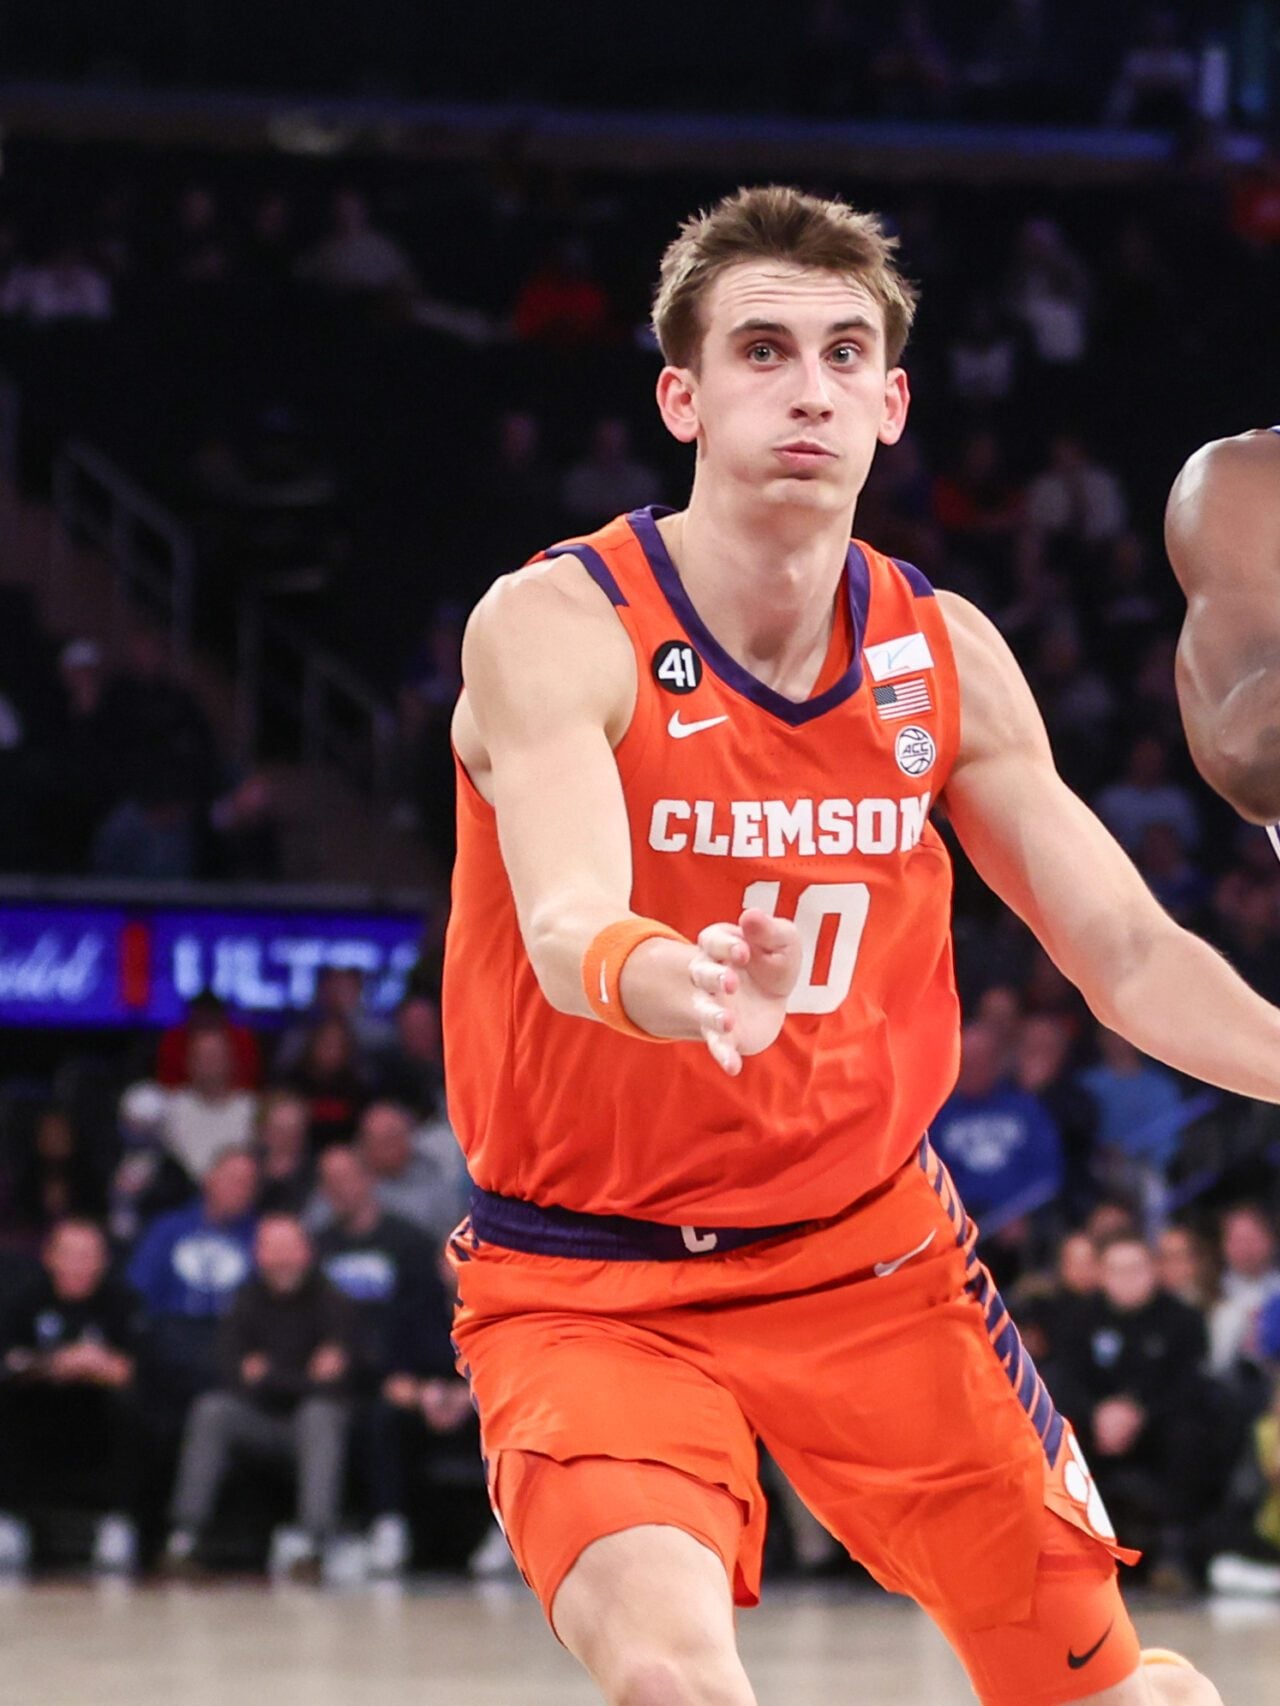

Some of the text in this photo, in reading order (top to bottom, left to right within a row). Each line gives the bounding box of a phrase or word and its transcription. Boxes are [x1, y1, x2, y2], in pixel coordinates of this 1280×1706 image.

[657, 647, 697, 688] 41
[902, 741, 929, 755] ACC
[648, 791, 932, 859] CLEMSON
